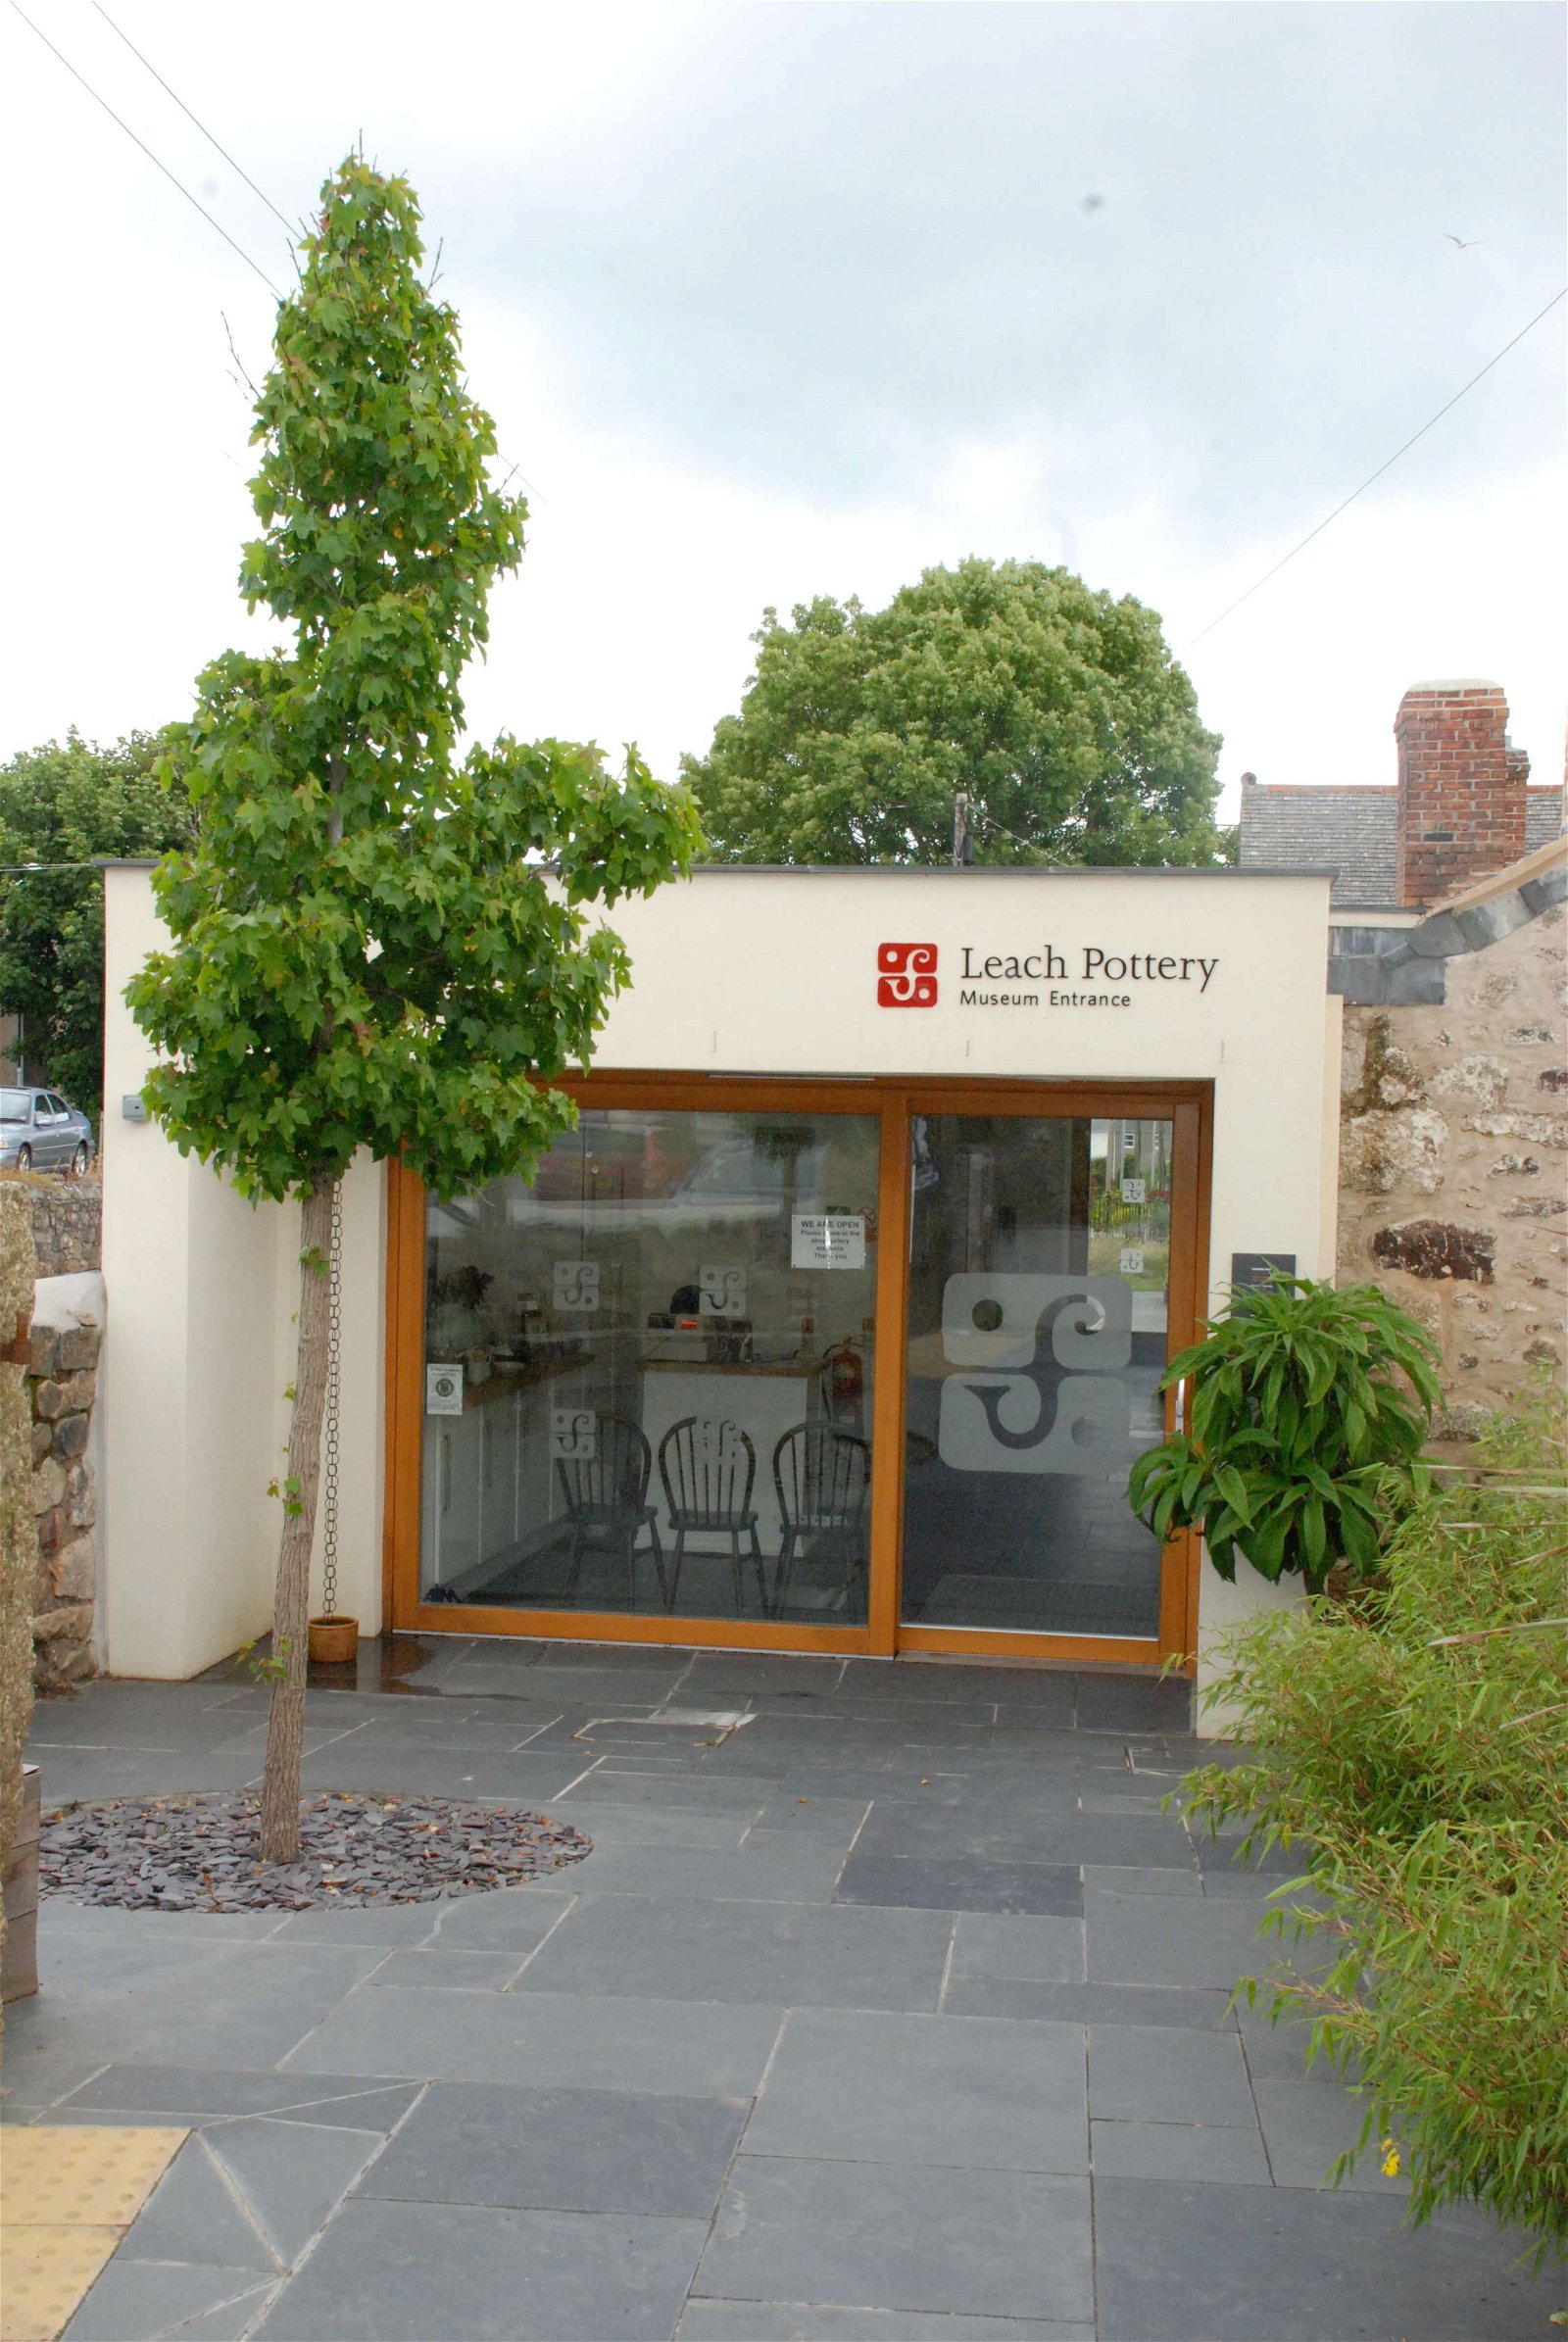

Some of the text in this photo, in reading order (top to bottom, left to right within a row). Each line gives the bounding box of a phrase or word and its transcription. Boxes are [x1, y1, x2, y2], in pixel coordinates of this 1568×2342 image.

[960, 945, 1219, 993] Leach Pottery
[959, 990, 1131, 1006] Museum Entrance
